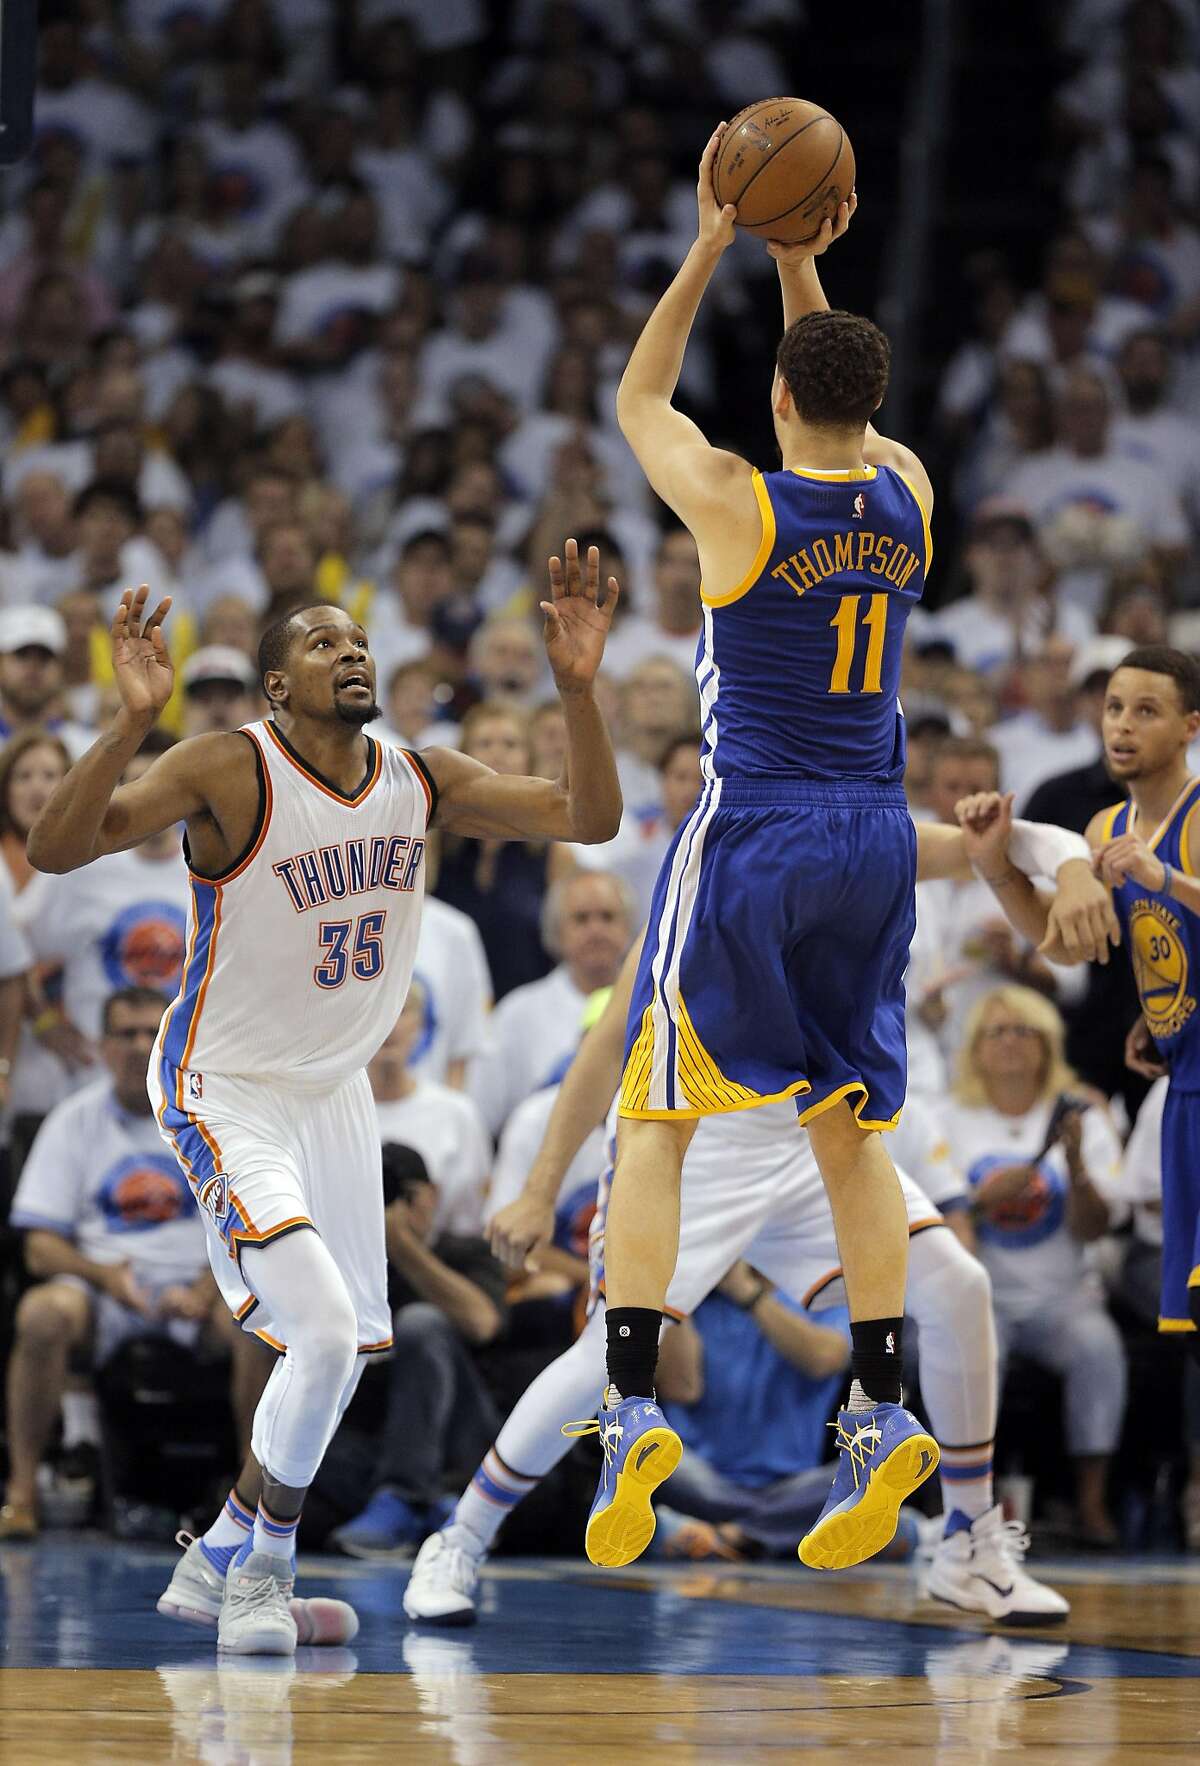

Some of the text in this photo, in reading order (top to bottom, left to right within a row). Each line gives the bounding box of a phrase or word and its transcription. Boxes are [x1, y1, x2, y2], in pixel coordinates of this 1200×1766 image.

[771, 532, 919, 596] THOMPSON
[827, 593, 889, 694] 11
[272, 835, 425, 913] THUNDER
[313, 910, 387, 990] 35
[1150, 935, 1171, 961] 30
